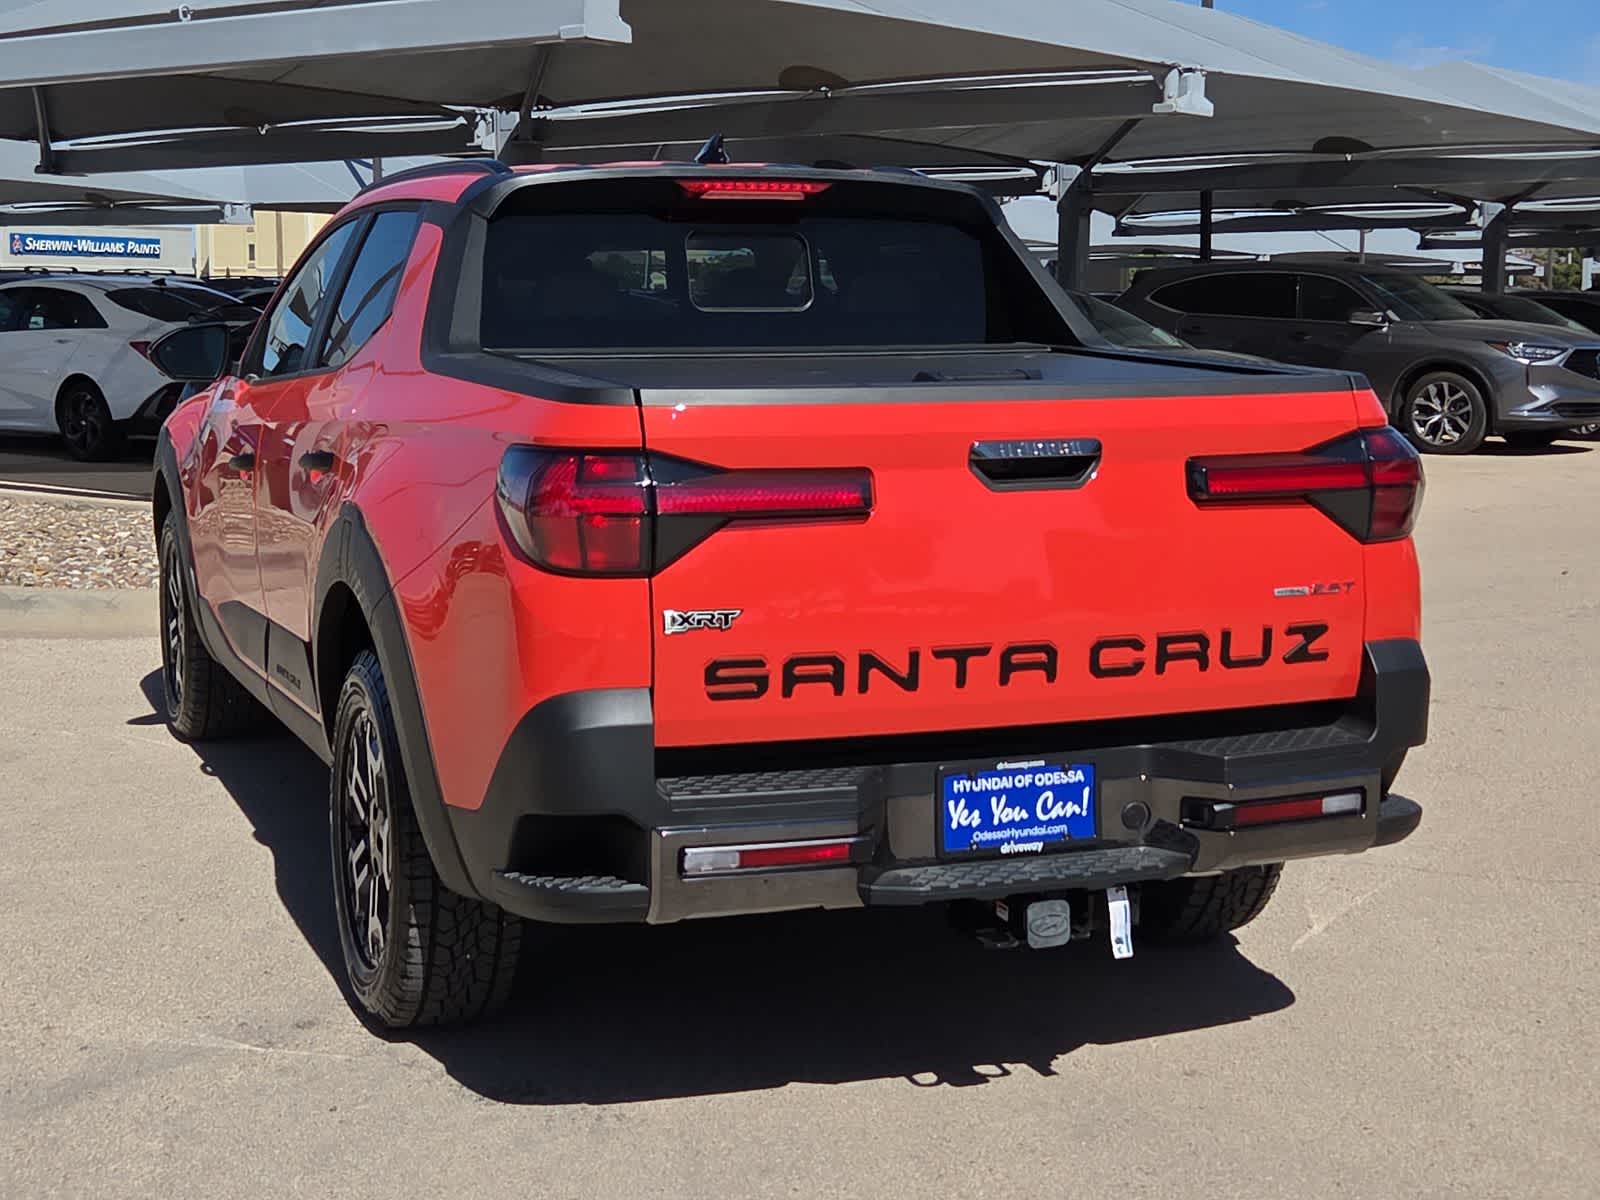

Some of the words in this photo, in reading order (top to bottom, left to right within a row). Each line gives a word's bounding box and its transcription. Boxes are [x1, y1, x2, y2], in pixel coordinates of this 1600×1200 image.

[25, 237, 124, 253] SHERWIN-WILLIAMS
[127, 241, 160, 255] PAINTS
[672, 609, 742, 631] XRT
[703, 639, 1059, 702] SANTA
[1088, 621, 1330, 680] CRUZ
[953, 775, 1013, 793] HYUNDAI
[1014, 774, 1033, 788] OF
[1034, 770, 1085, 787] ODESSA
[948, 798, 981, 830] Yes
[990, 794, 1029, 826] You
[1036, 786, 1090, 821] Can!
[972, 824, 1068, 842] OdessaHyundai.com
[1000, 841, 1044, 855] driveway
